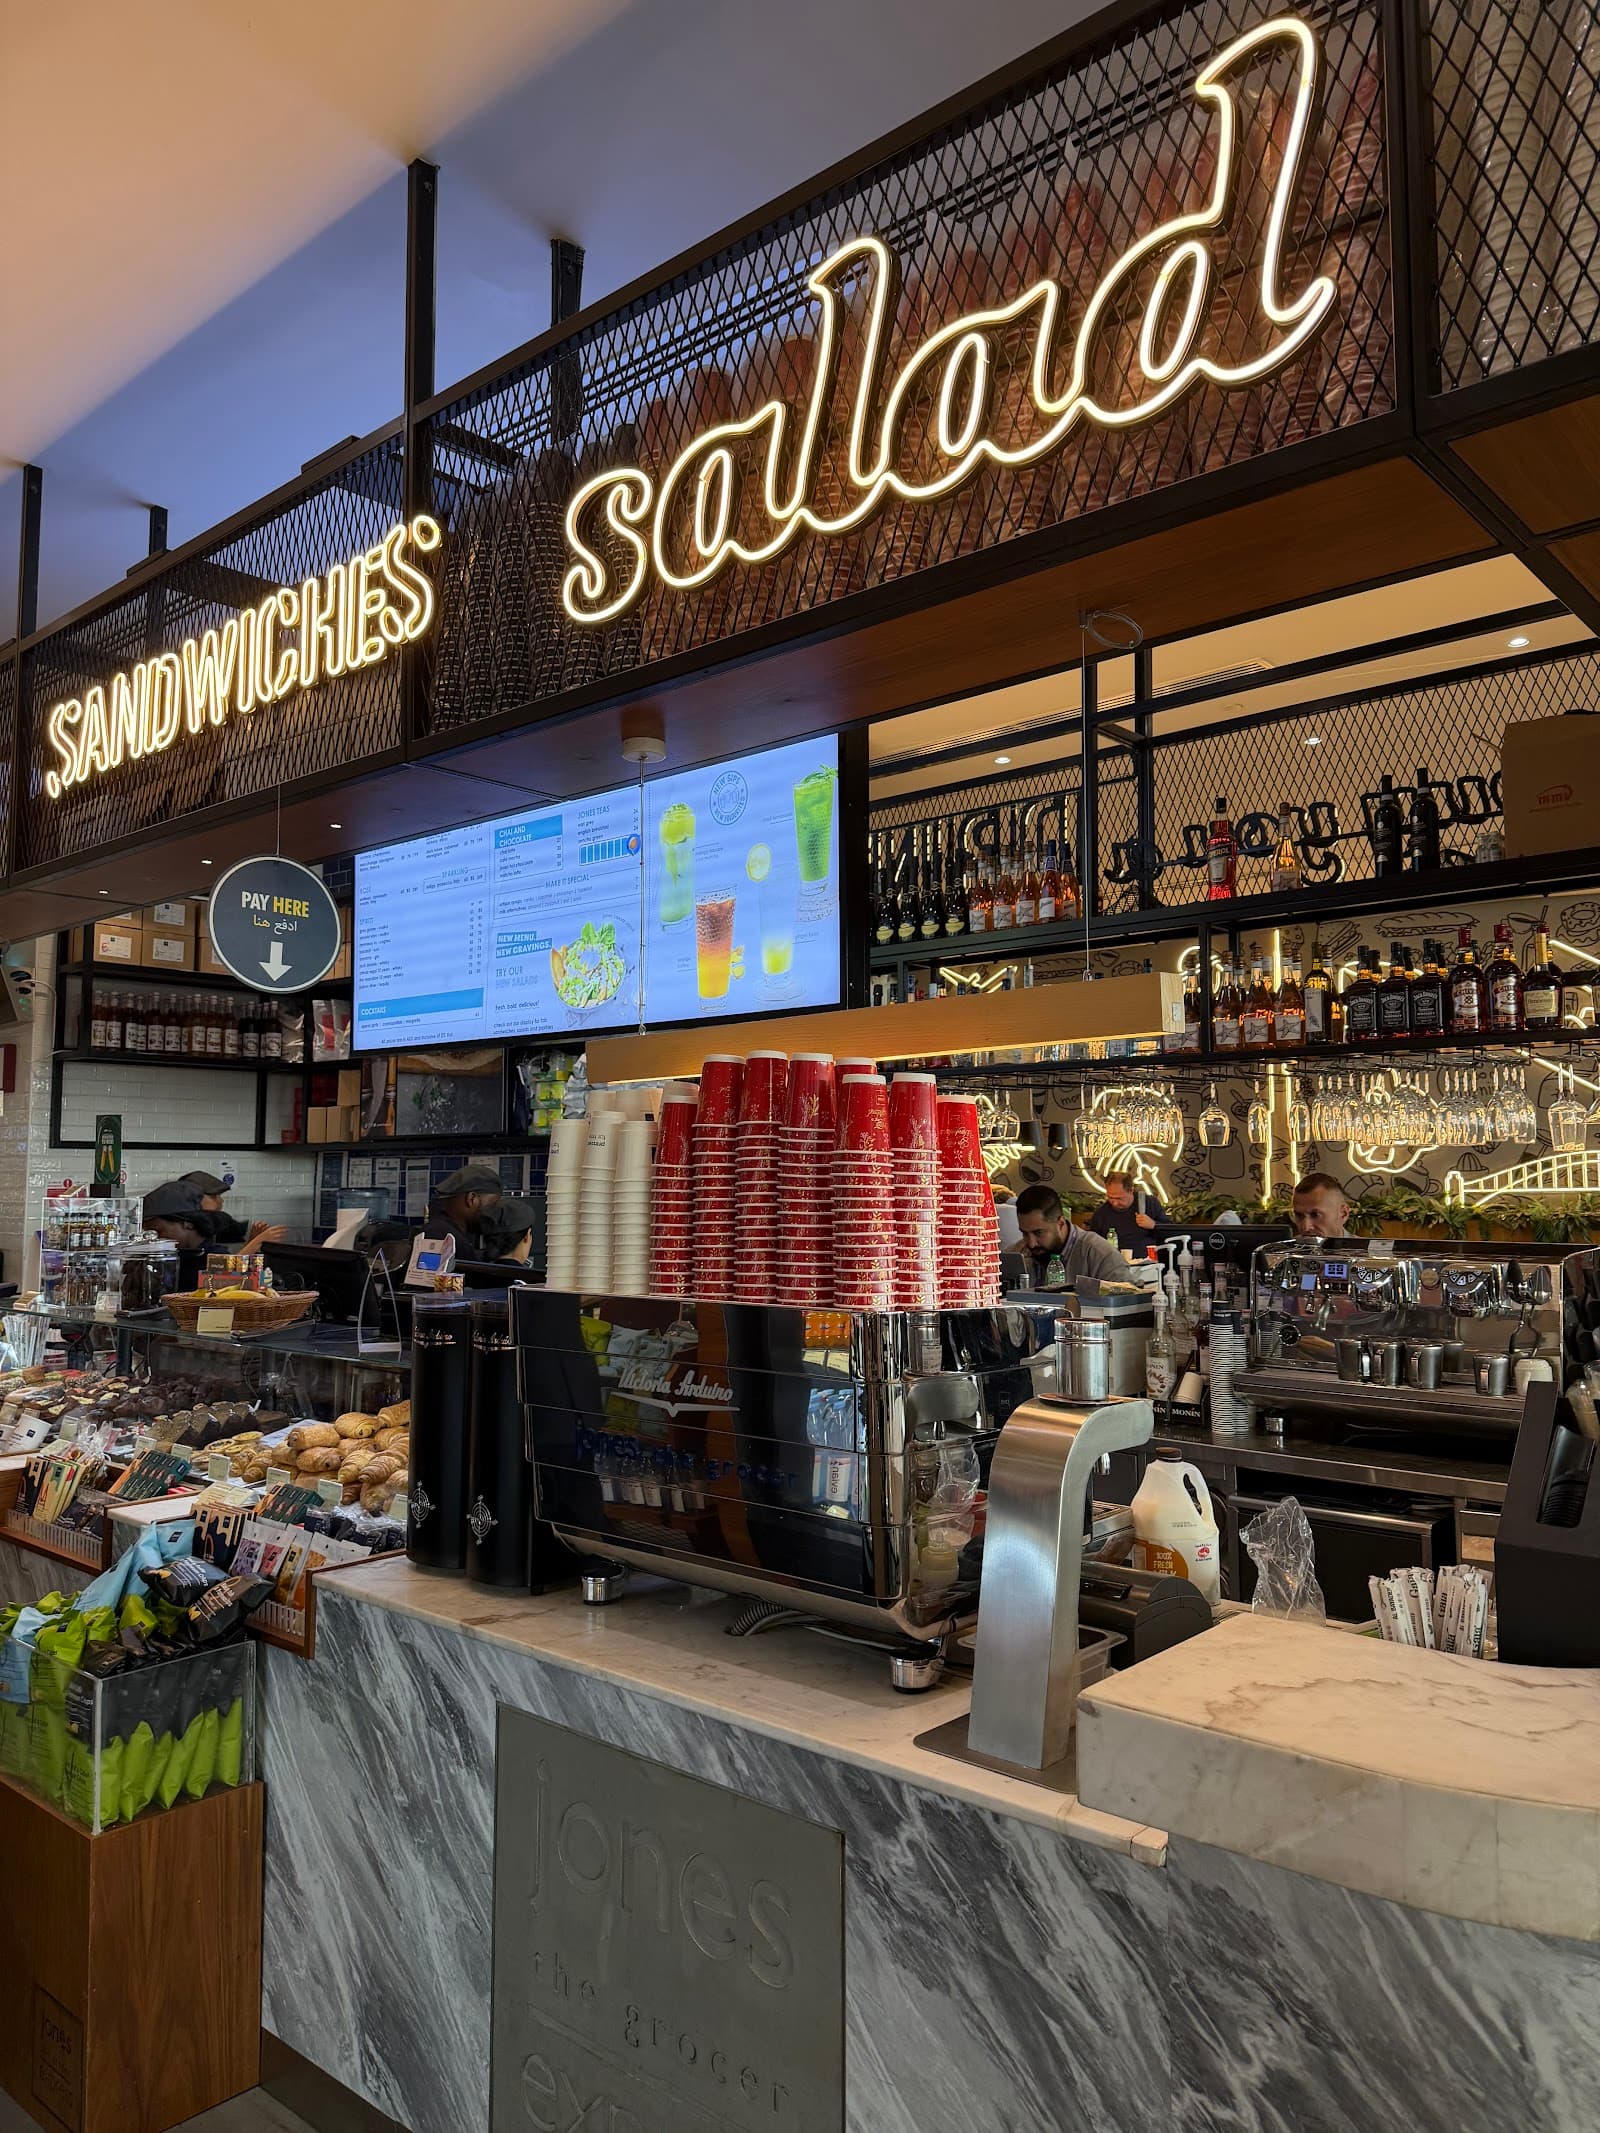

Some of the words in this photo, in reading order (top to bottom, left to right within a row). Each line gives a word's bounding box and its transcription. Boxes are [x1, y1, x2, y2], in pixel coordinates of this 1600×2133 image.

[563, 17, 1338, 623] salad
[45, 515, 443, 799] SANDWICHES
[578, 808, 596, 819] JONES
[597, 804, 610, 815] TEAS
[499, 828, 513, 838] CHAI
[513, 825, 526, 834] AND
[499, 834, 532, 847] CHOCOLATE
[545, 879, 561, 888] MAKE
[567, 874, 590, 885] SPECIAL
[241, 891, 271, 912] PAY
[272, 895, 310, 918] HERE
[252, 914, 271, 928] هنا
[273, 918, 298, 935] ادفع
[497, 934, 514, 943] NEW
[496, 947, 512, 957] NEW
[617, 1366, 671, 1394] Victoria
[673, 1369, 734, 1401] Arduino
[1153, 1403, 1166, 1414] NIN
[1155, 1551, 1173, 1560] 100%
[1153, 1560, 1174, 1569] FRESH
[529, 1757, 796, 1991] jones
[623, 2003, 790, 2114] grocer
